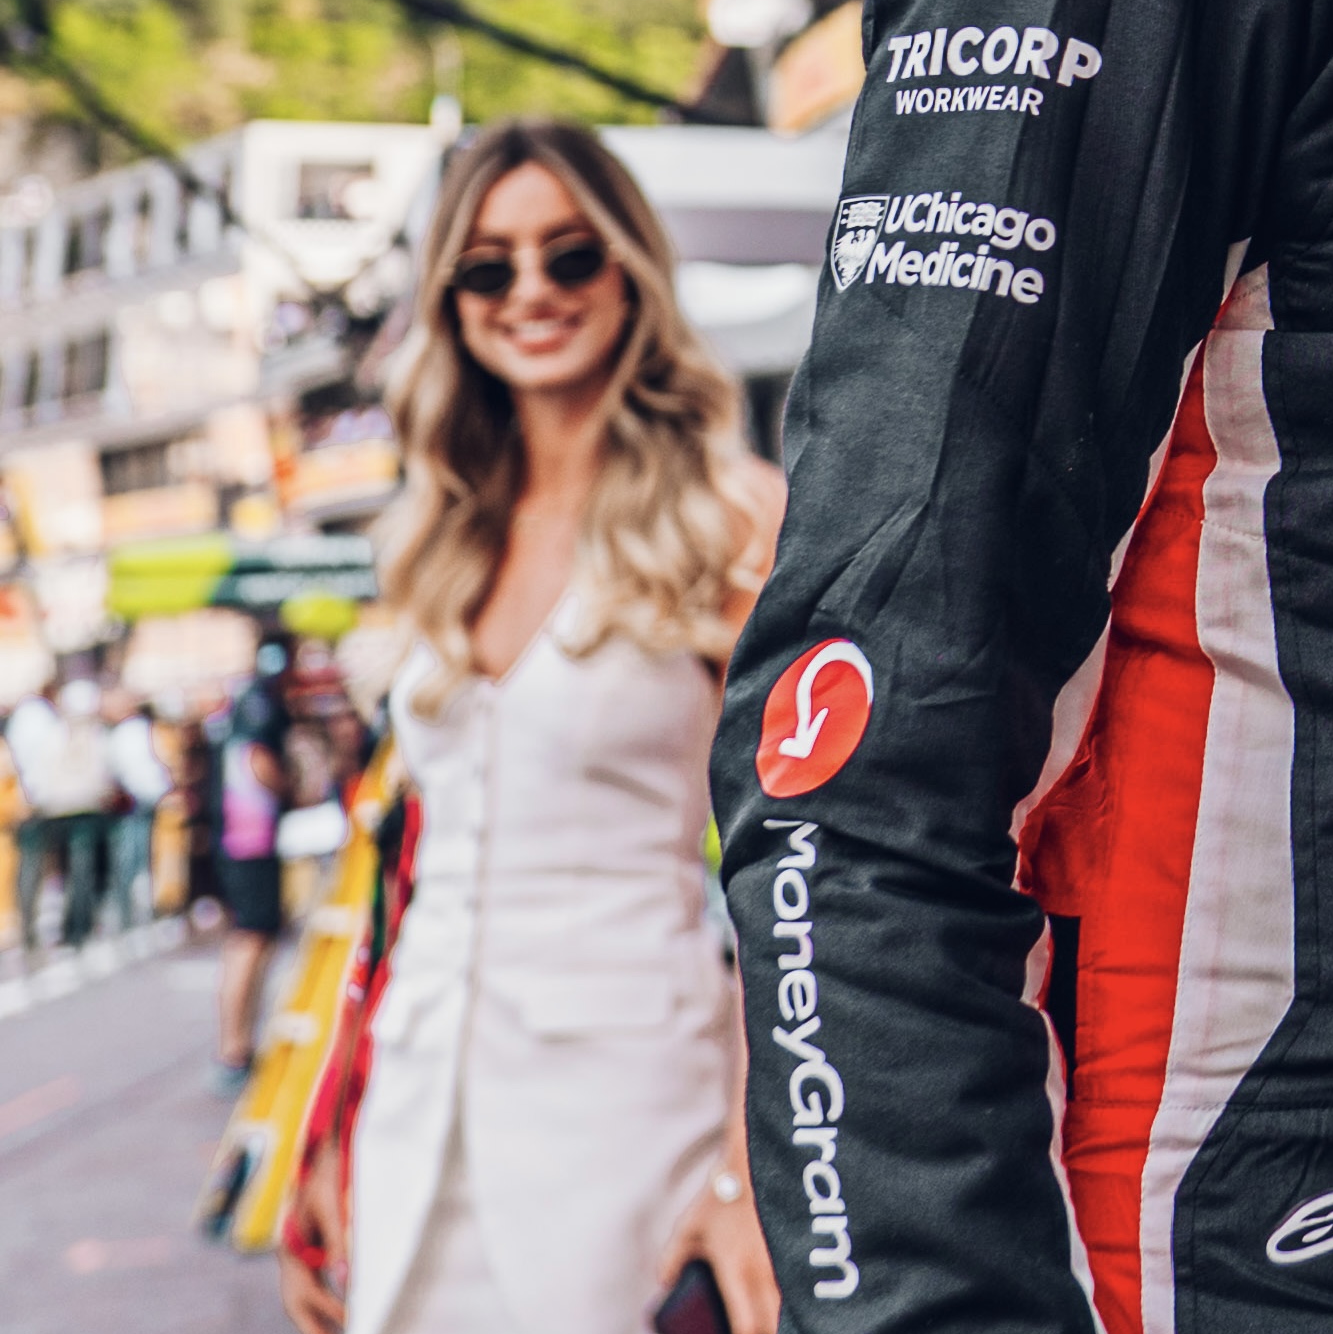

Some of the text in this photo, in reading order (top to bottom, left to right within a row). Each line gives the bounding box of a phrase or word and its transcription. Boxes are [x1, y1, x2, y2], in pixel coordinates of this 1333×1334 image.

[886, 26, 1102, 87] TRICORP
[896, 85, 1044, 116] WORKWEAR
[884, 191, 1056, 251] UChicago
[865, 240, 1044, 304] Medicine
[762, 818, 859, 1299] MoneyGram
